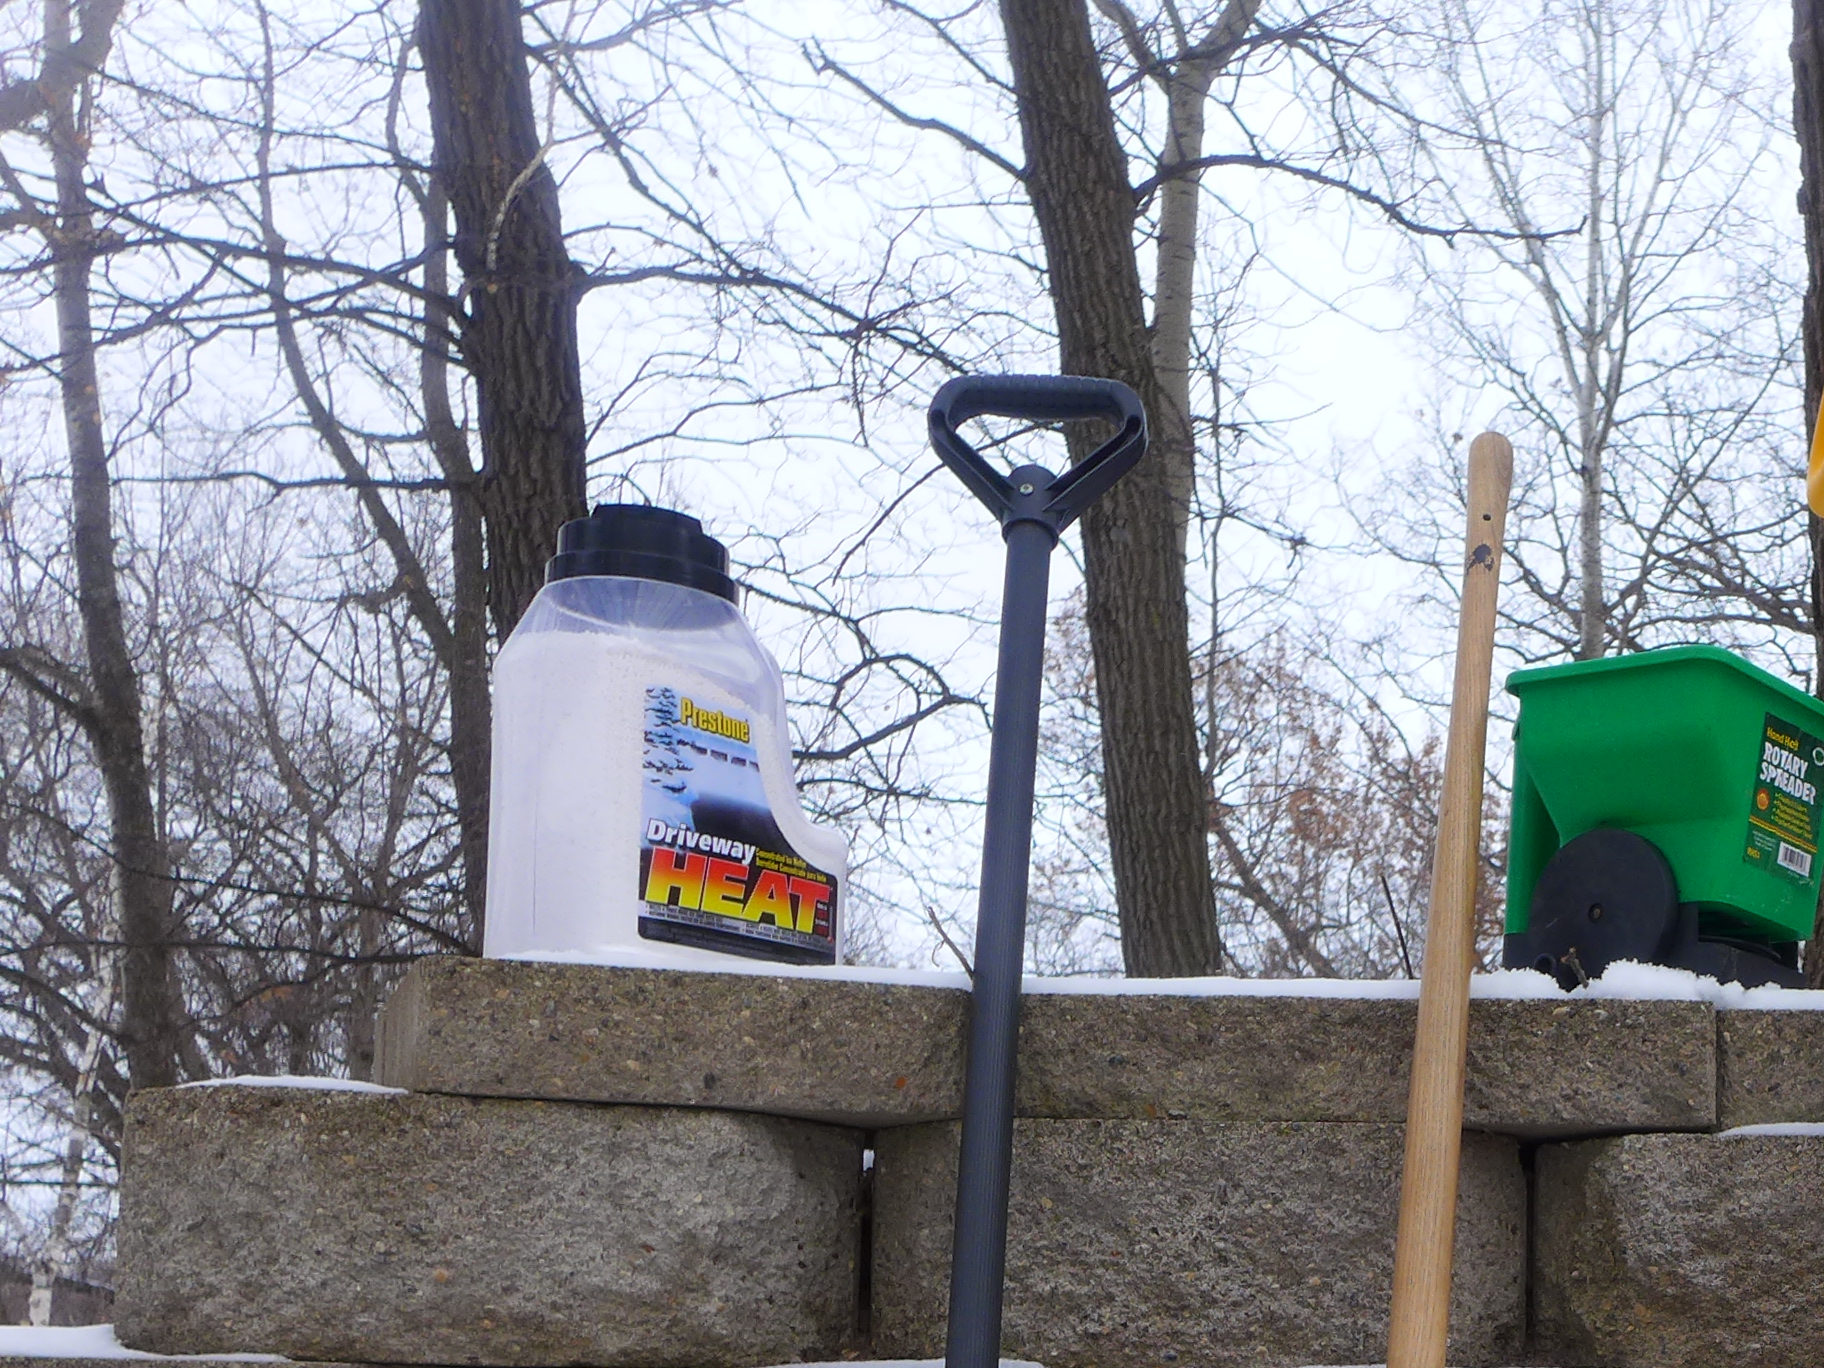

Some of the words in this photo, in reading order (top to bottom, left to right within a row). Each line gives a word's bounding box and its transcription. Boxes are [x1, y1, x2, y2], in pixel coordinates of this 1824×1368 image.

[680, 697, 750, 744] Prestone
[1760, 761, 1817, 806] SPREADER
[1762, 741, 1809, 780] ROTARY
[647, 817, 757, 867] Driveway
[643, 845, 831, 935] HEAT
